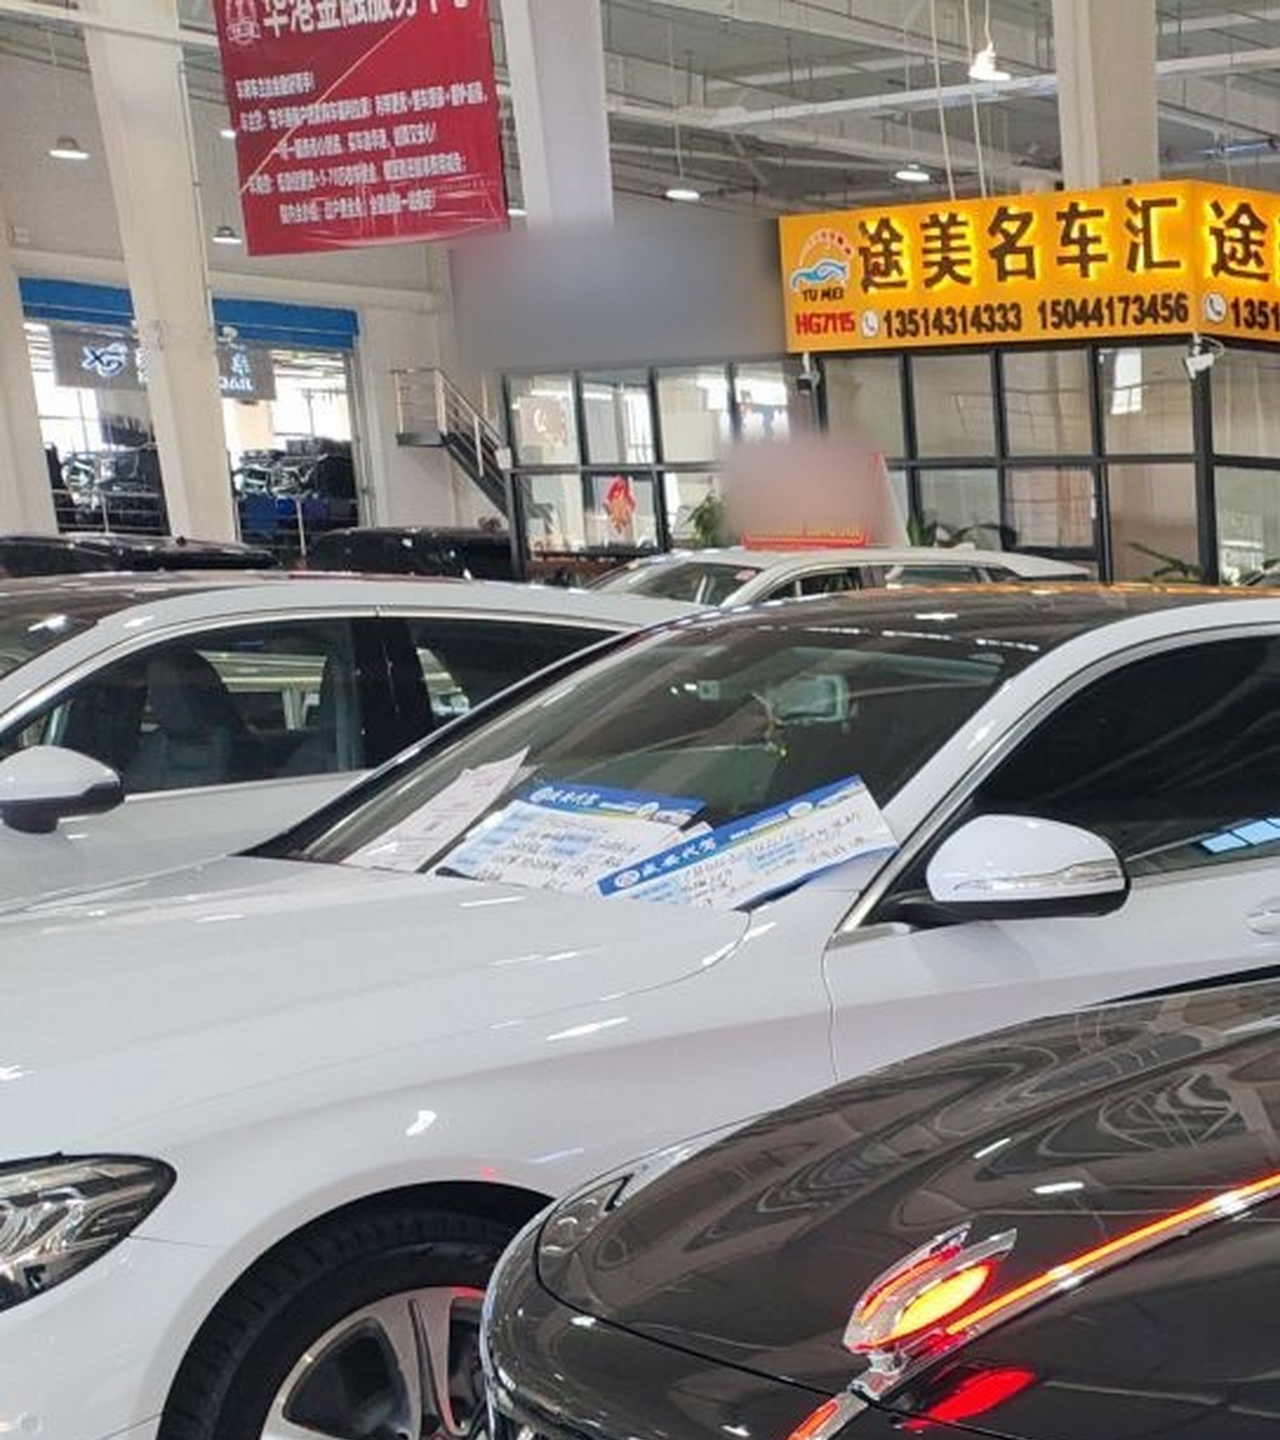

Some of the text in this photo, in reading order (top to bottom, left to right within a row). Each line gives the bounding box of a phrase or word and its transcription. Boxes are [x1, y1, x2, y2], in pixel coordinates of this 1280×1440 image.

[859, 197, 1181, 293] 途美名车汇
[802, 288, 818, 302] TU
[883, 293, 1189, 338] 13514314333 15044173456
